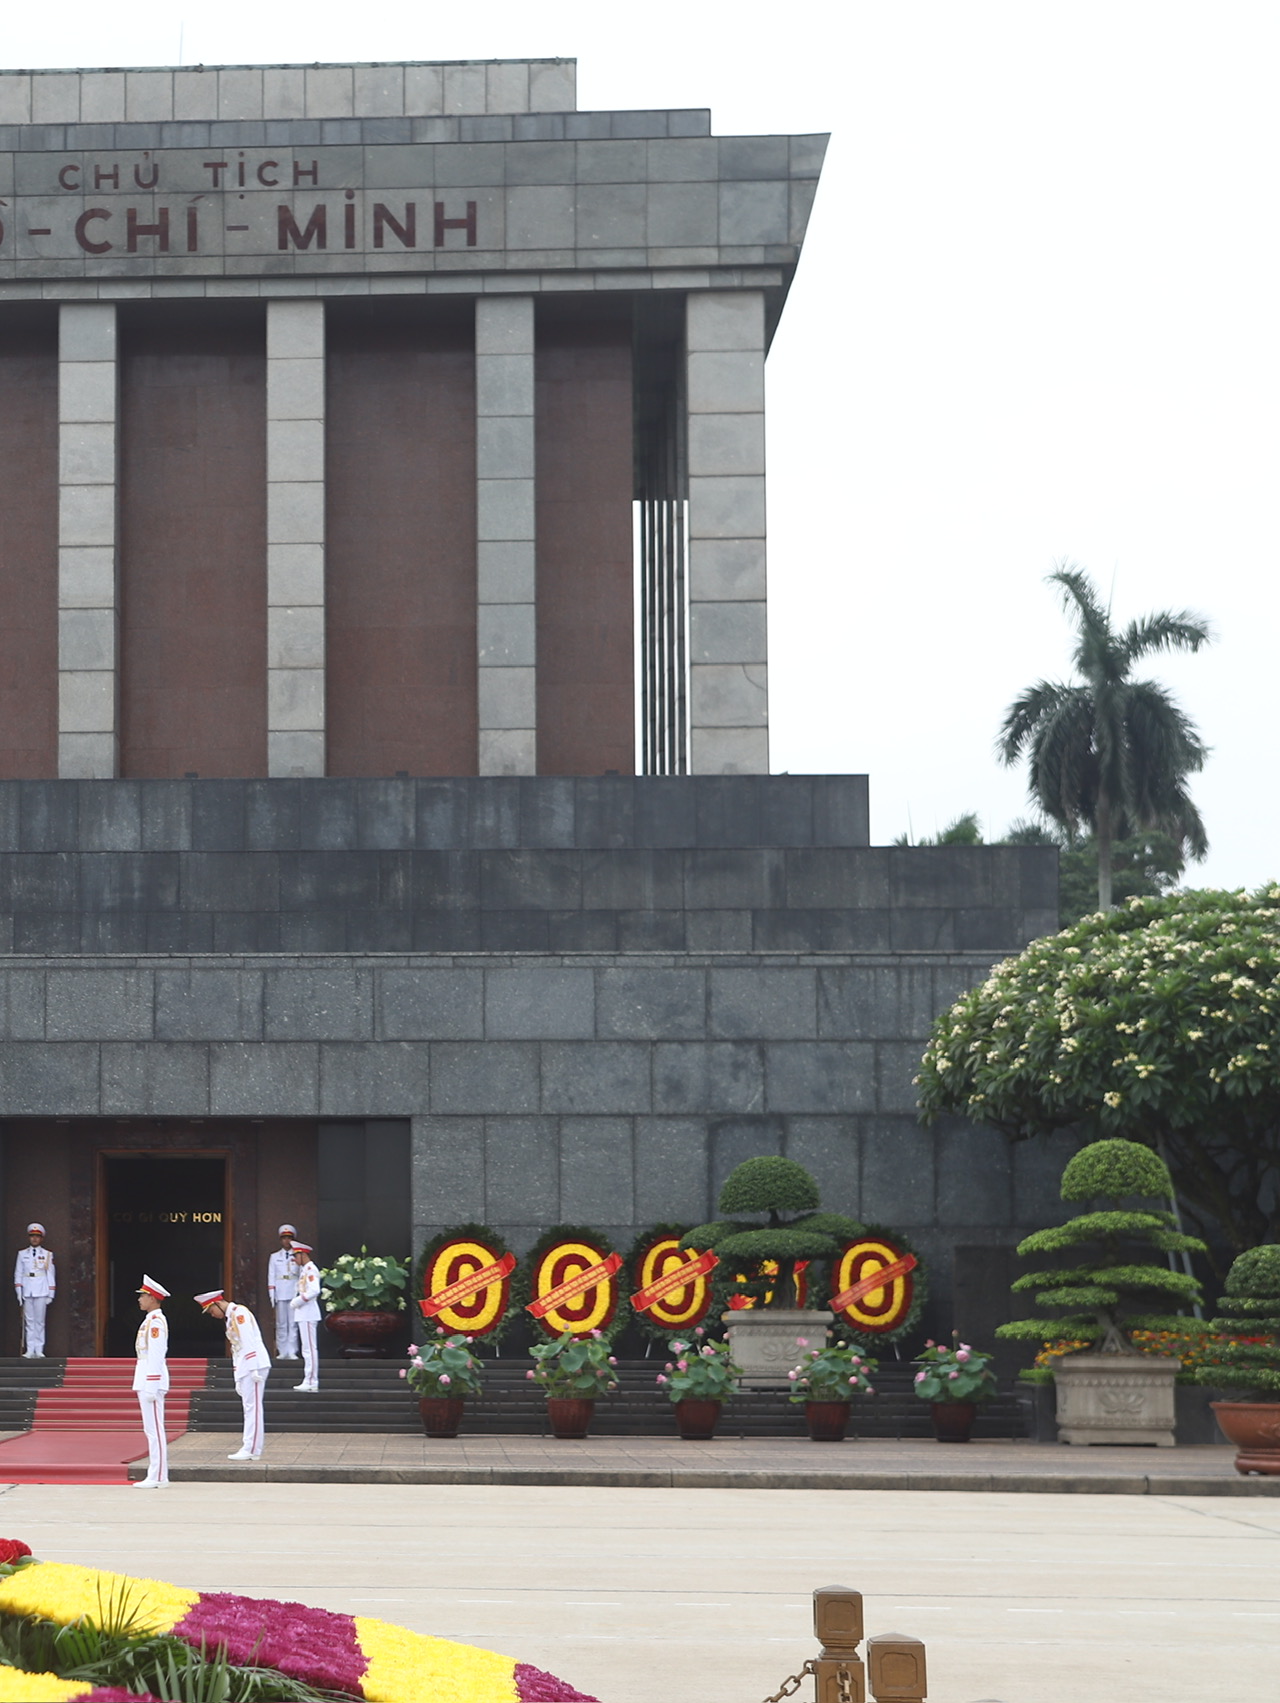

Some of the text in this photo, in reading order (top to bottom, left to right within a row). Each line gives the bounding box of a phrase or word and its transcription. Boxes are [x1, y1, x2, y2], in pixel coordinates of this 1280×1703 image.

[58, 151, 318, 200] CHỦ TỊCH
[74, 195, 205, 255] CHÍ
